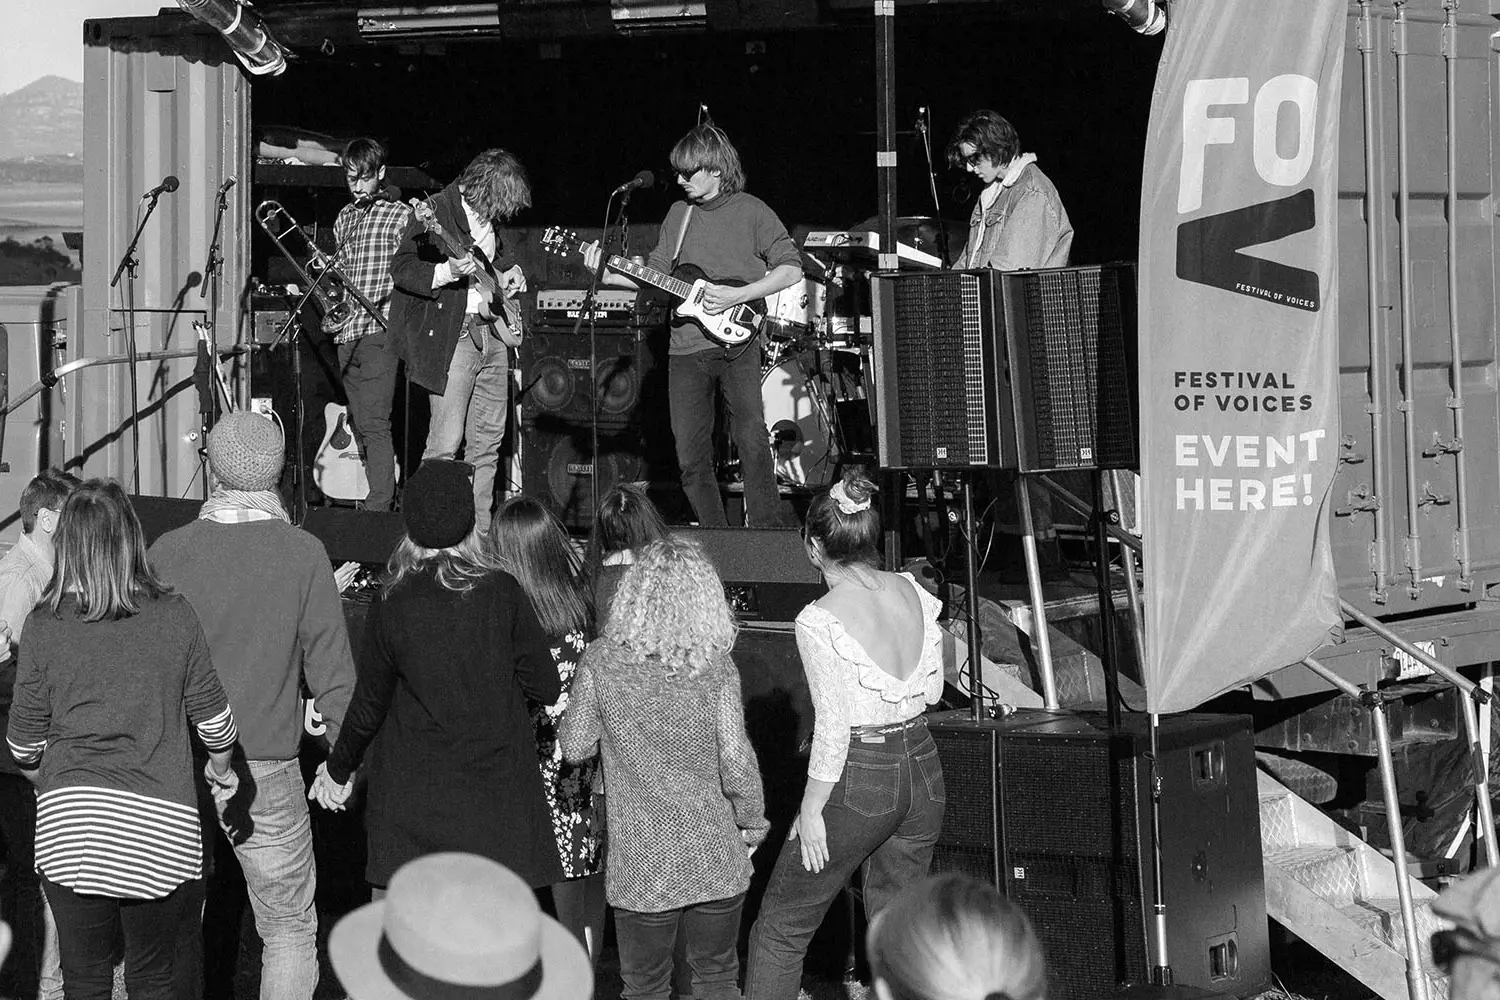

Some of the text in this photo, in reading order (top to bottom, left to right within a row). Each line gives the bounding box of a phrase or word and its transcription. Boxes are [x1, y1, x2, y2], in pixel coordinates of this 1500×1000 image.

[1177, 73, 1319, 215] FO
[1235, 282, 1315, 308] FESTIVAL OF VOICES
[1174, 371, 1295, 389] FESTIVAL
[1174, 394, 1312, 412] OF VOICES
[1175, 428, 1326, 468] EVENT
[1176, 473, 1313, 511] HERE!
